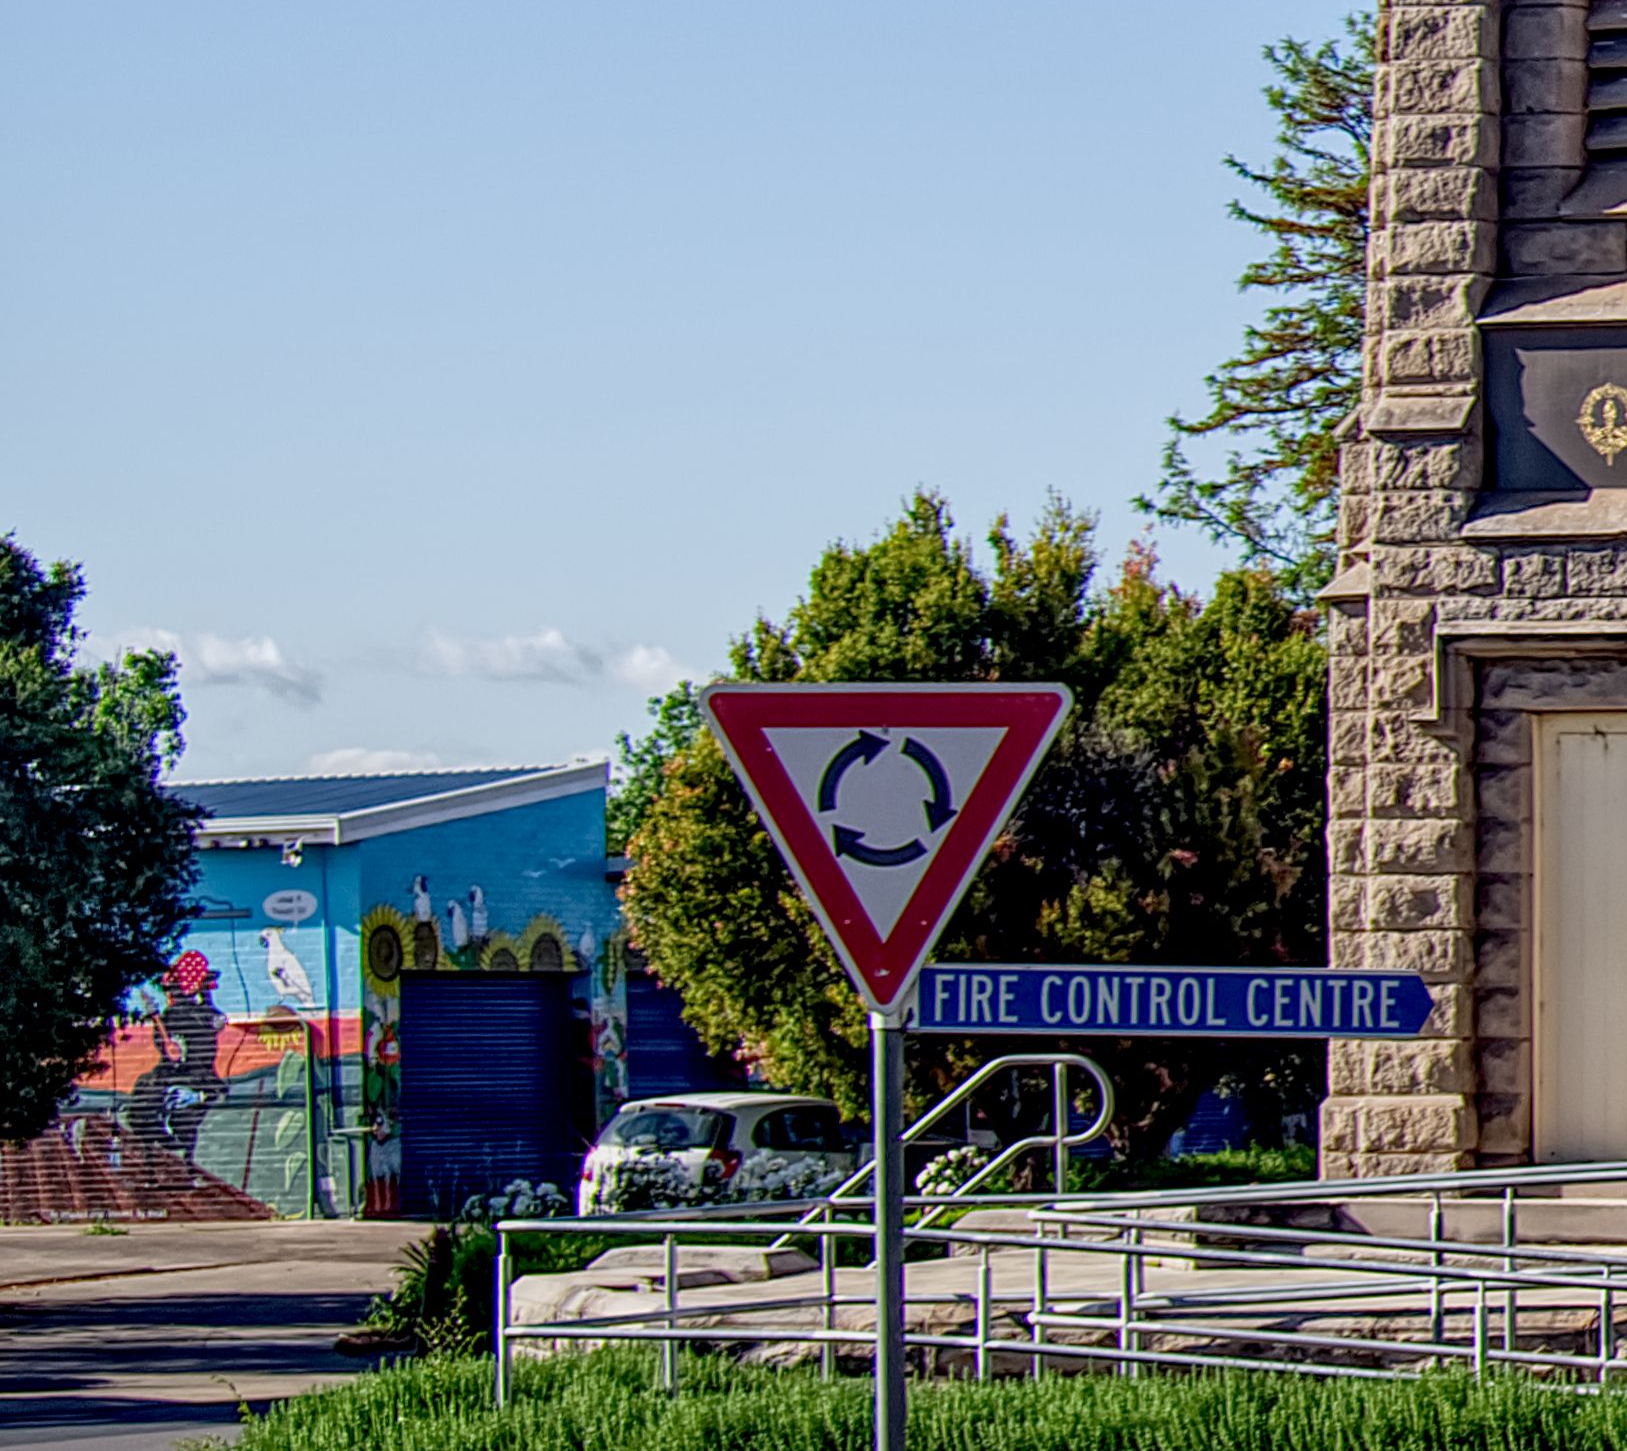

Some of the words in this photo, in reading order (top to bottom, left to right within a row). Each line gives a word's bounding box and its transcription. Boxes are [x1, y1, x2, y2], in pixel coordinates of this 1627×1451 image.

[934, 974, 1018, 1023] FIRE
[1041, 975, 1227, 1028] CONTROL
[1246, 978, 1401, 1030] CENTRE
